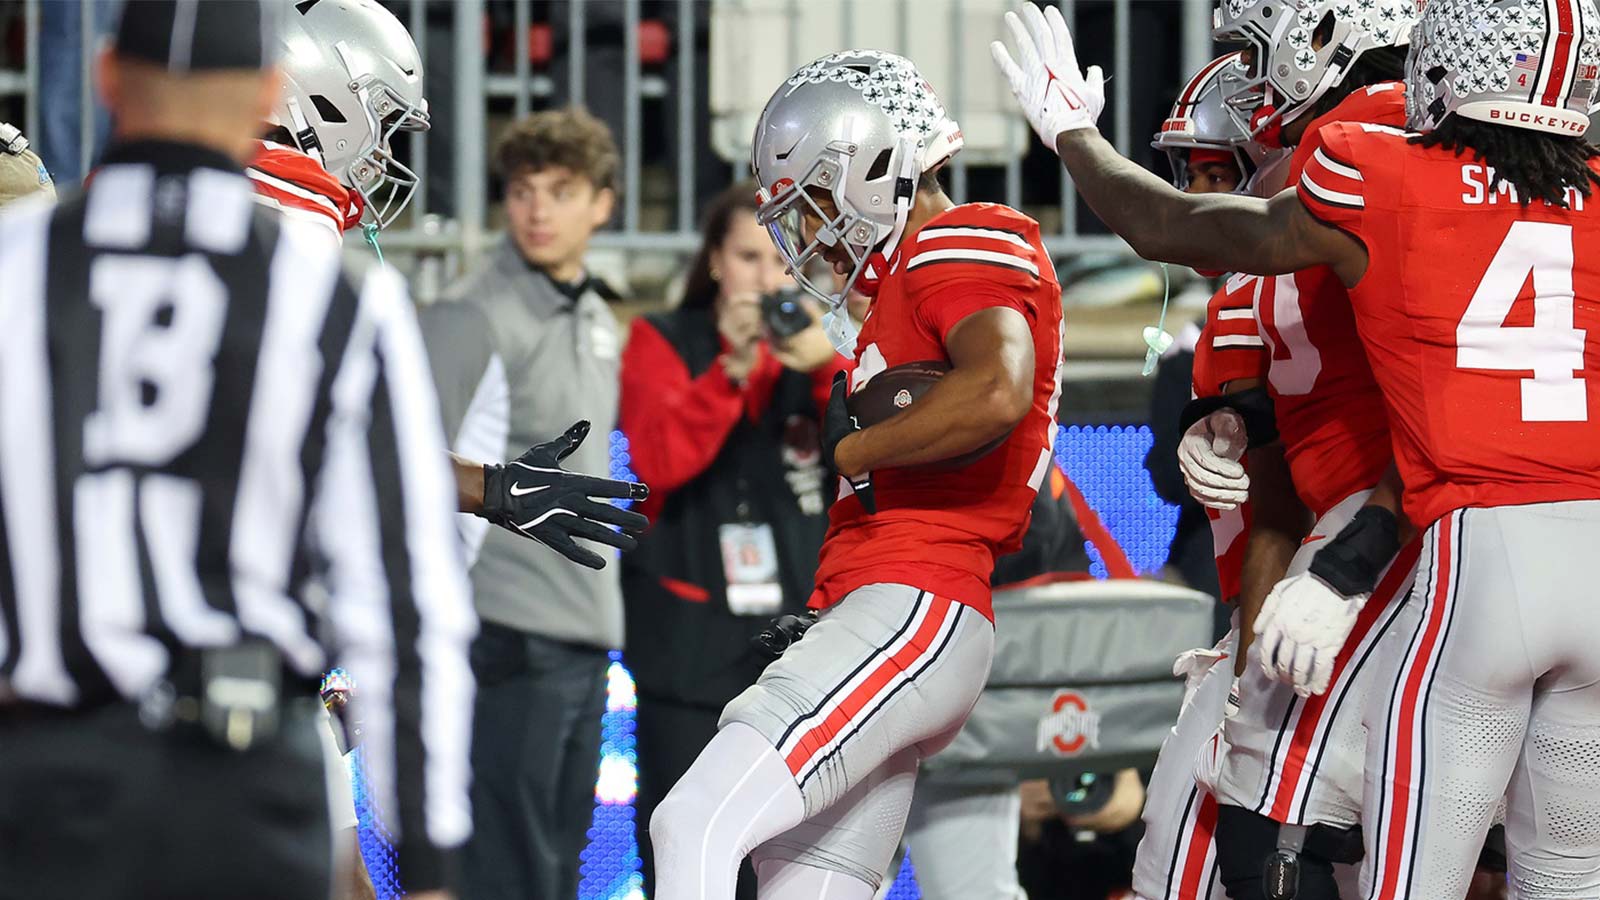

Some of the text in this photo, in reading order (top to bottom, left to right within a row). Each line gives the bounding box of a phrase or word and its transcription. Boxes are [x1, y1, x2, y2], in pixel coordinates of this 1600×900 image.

[1490, 109, 1585, 133] BUCKEYES
[1517, 73, 1527, 87] 4
[84, 253, 229, 467] B
[1456, 220, 1588, 422] 4
